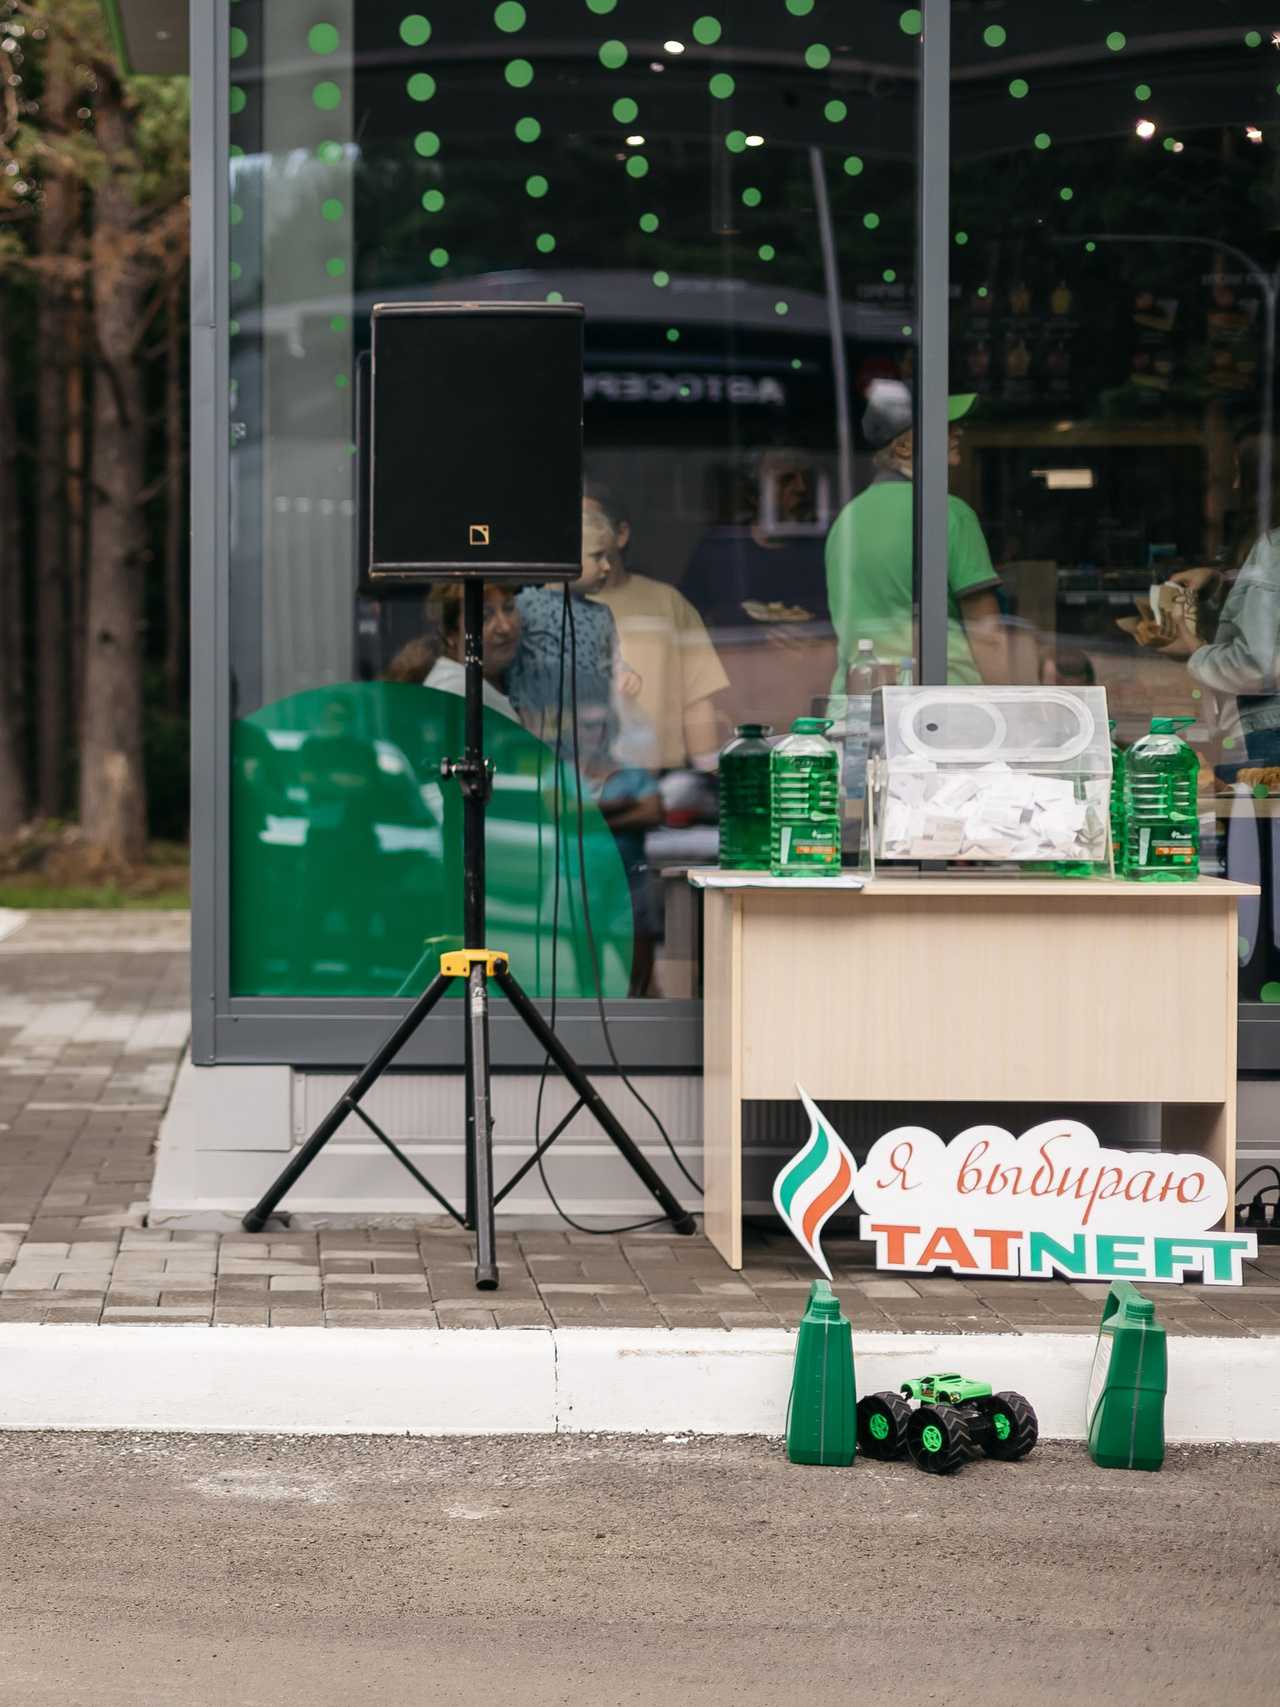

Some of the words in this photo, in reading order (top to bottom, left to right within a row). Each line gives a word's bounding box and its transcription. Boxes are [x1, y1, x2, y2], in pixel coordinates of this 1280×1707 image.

[877, 1141, 923, 1191] Я
[956, 1133, 1212, 1226] выбираю
[870, 1223, 1249, 1281] TATNEFT
